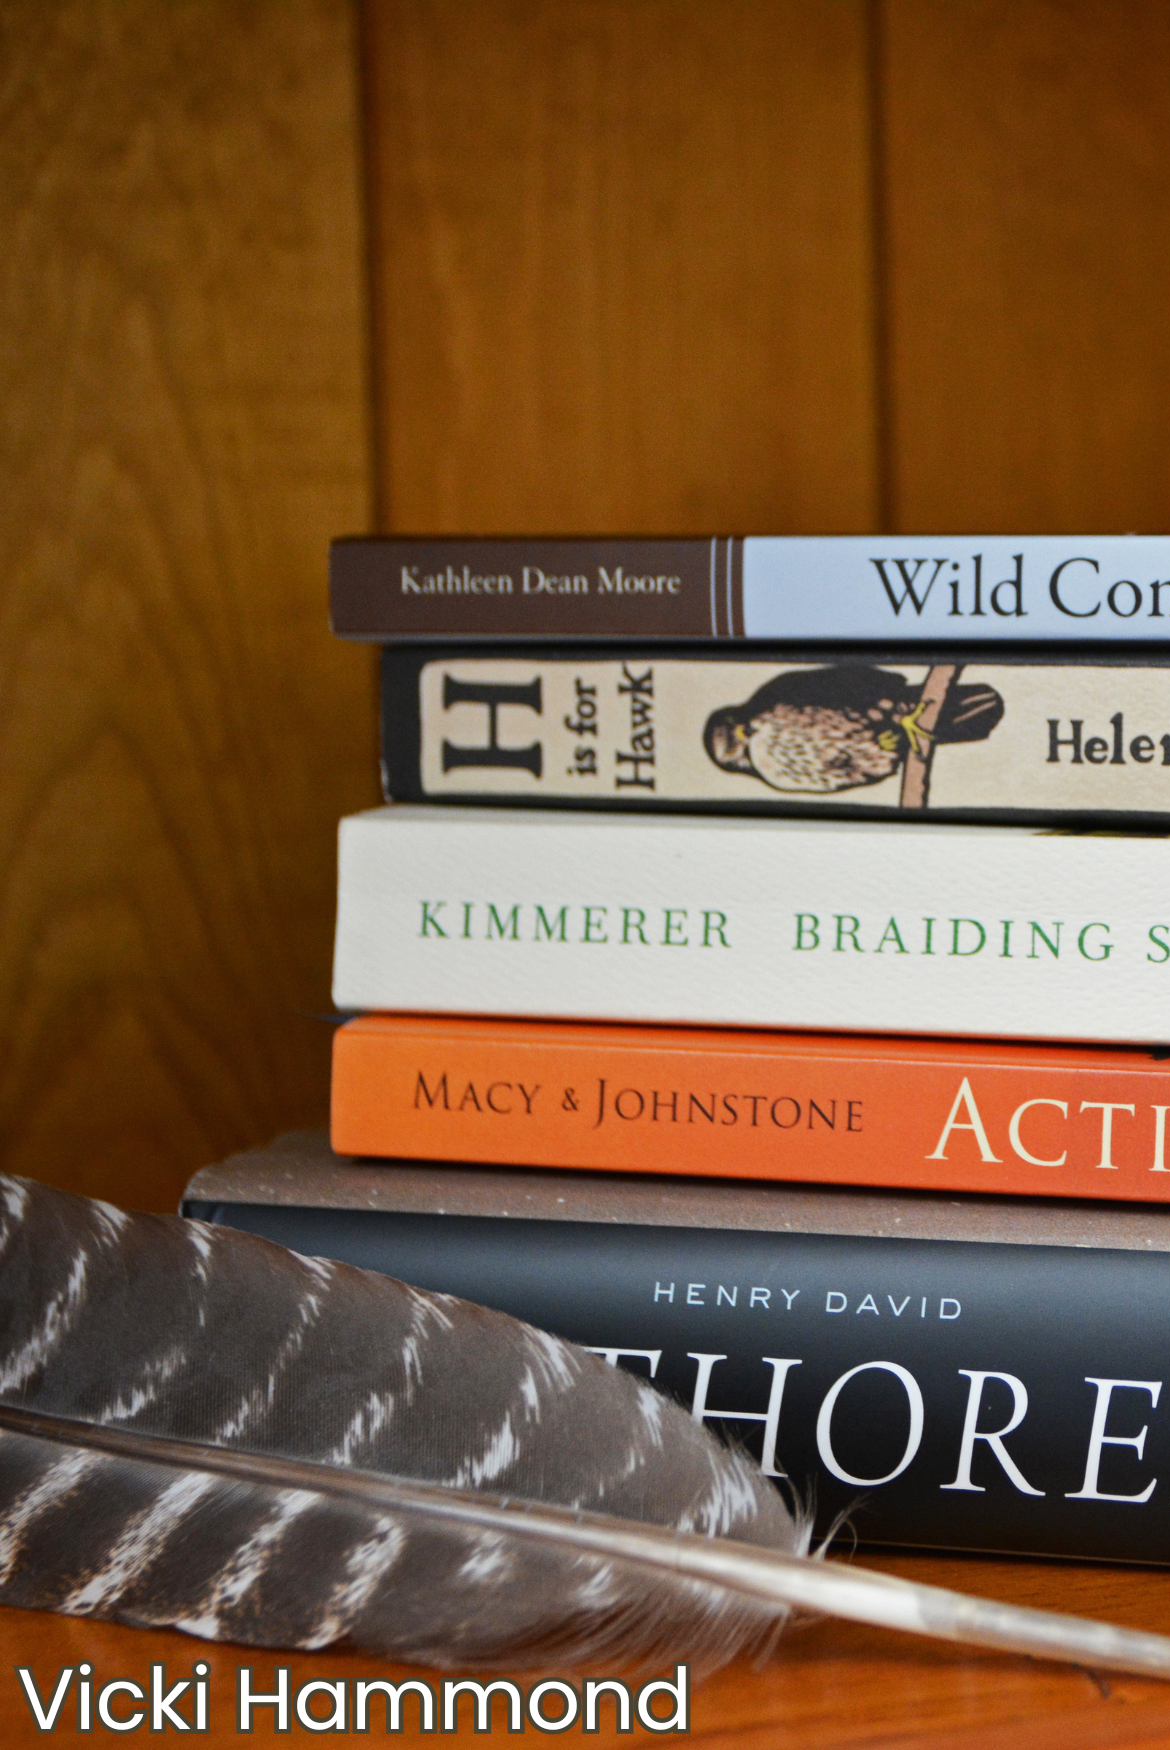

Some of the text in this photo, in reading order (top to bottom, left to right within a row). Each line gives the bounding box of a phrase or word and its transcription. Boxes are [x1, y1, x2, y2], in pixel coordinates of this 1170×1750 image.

[401, 565, 681, 594] Kathleen Dean Moore
[869, 553, 1029, 618] Wild
[441, 672, 543, 781] H
[563, 676, 599, 778] is for
[419, 901, 732, 948] KIMMERER
[793, 913, 1114, 962] BRAIDING
[562, 1088, 578, 1112] &
[653, 1281, 963, 1320] HENRY DAVID
